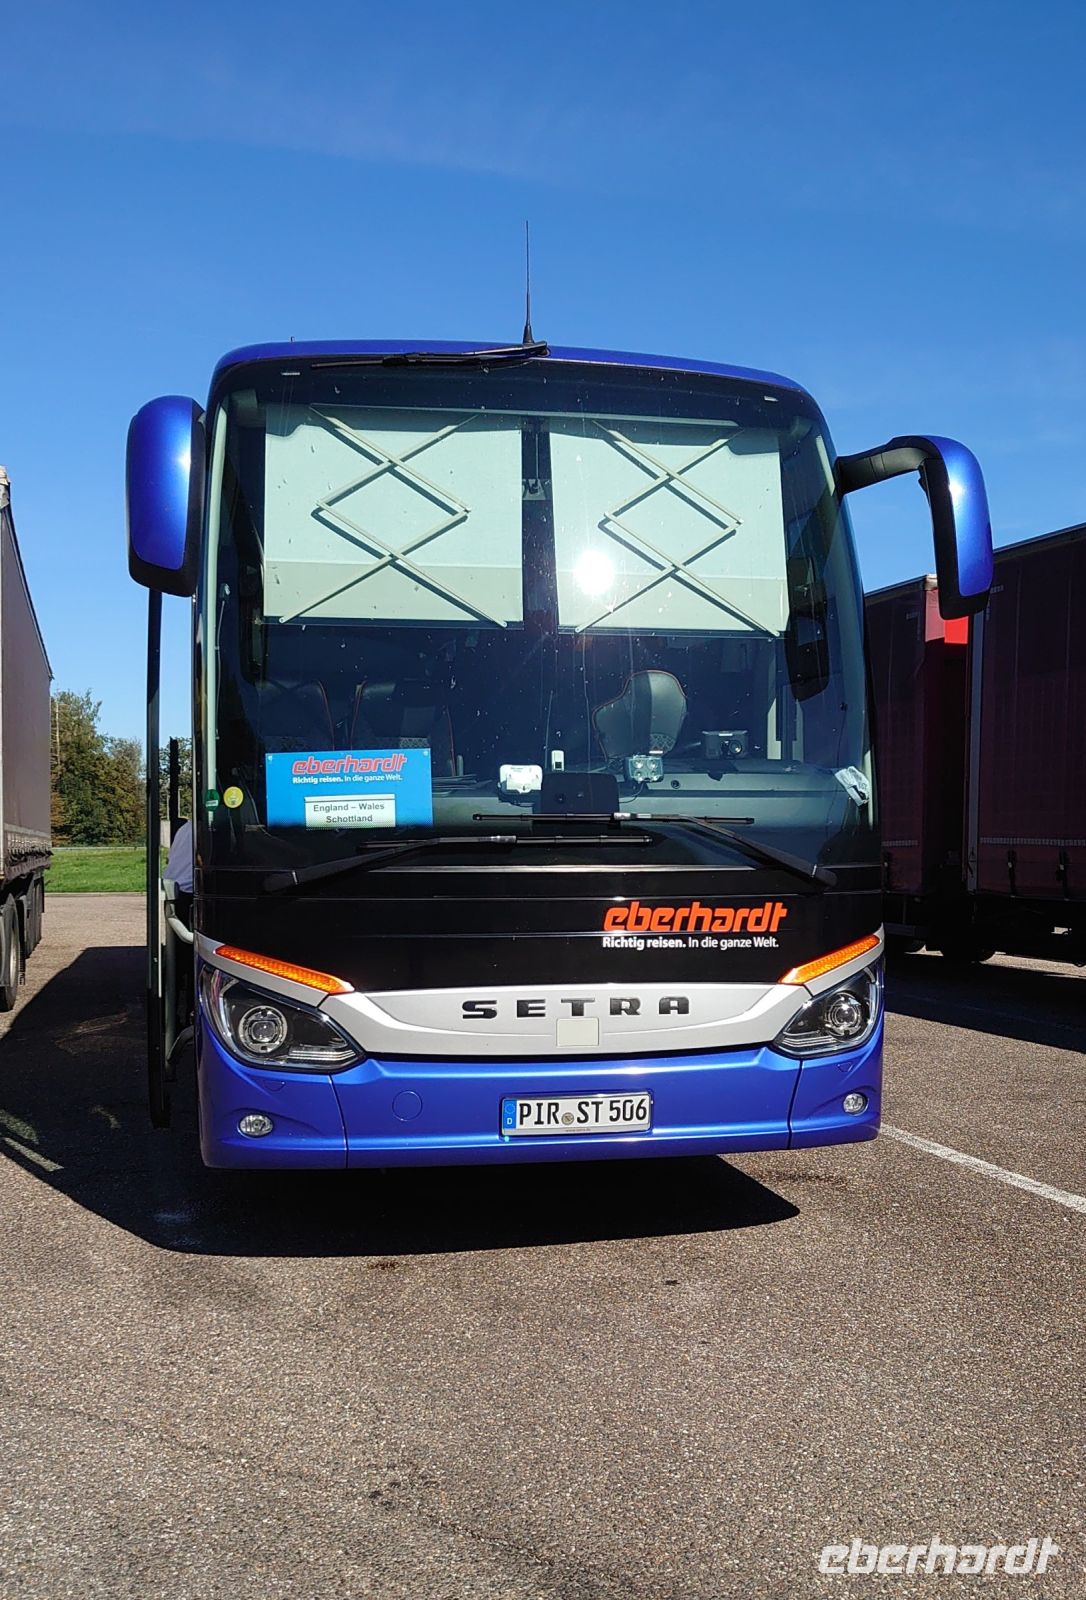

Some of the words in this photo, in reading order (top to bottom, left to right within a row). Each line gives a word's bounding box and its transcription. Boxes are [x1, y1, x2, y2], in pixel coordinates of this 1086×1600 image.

[292, 753, 407, 774] eberhardt
[293, 776, 318, 785] Richtig
[319, 775, 344, 783] reisen.
[352, 774, 363, 782] die
[364, 775, 385, 783] ganze
[385, 773, 403, 781] Welt.
[313, 804, 349, 813] England
[358, 802, 385, 811] Wales
[325, 815, 373, 824] Schottland
[603, 901, 788, 933] eberhardt
[602, 936, 645, 951] Richtig
[647, 936, 687, 948] reisen.
[688, 937, 699, 948] In
[701, 936, 718, 948] die
[720, 938, 752, 950] ganze
[753, 936, 779, 948] Welt.
[461, 995, 690, 1019] SETRA
[519, 1102, 560, 1126] PIR
[576, 1100, 604, 1124] ST
[608, 1098, 648, 1123] 506
[506, 1117, 513, 1125] D
